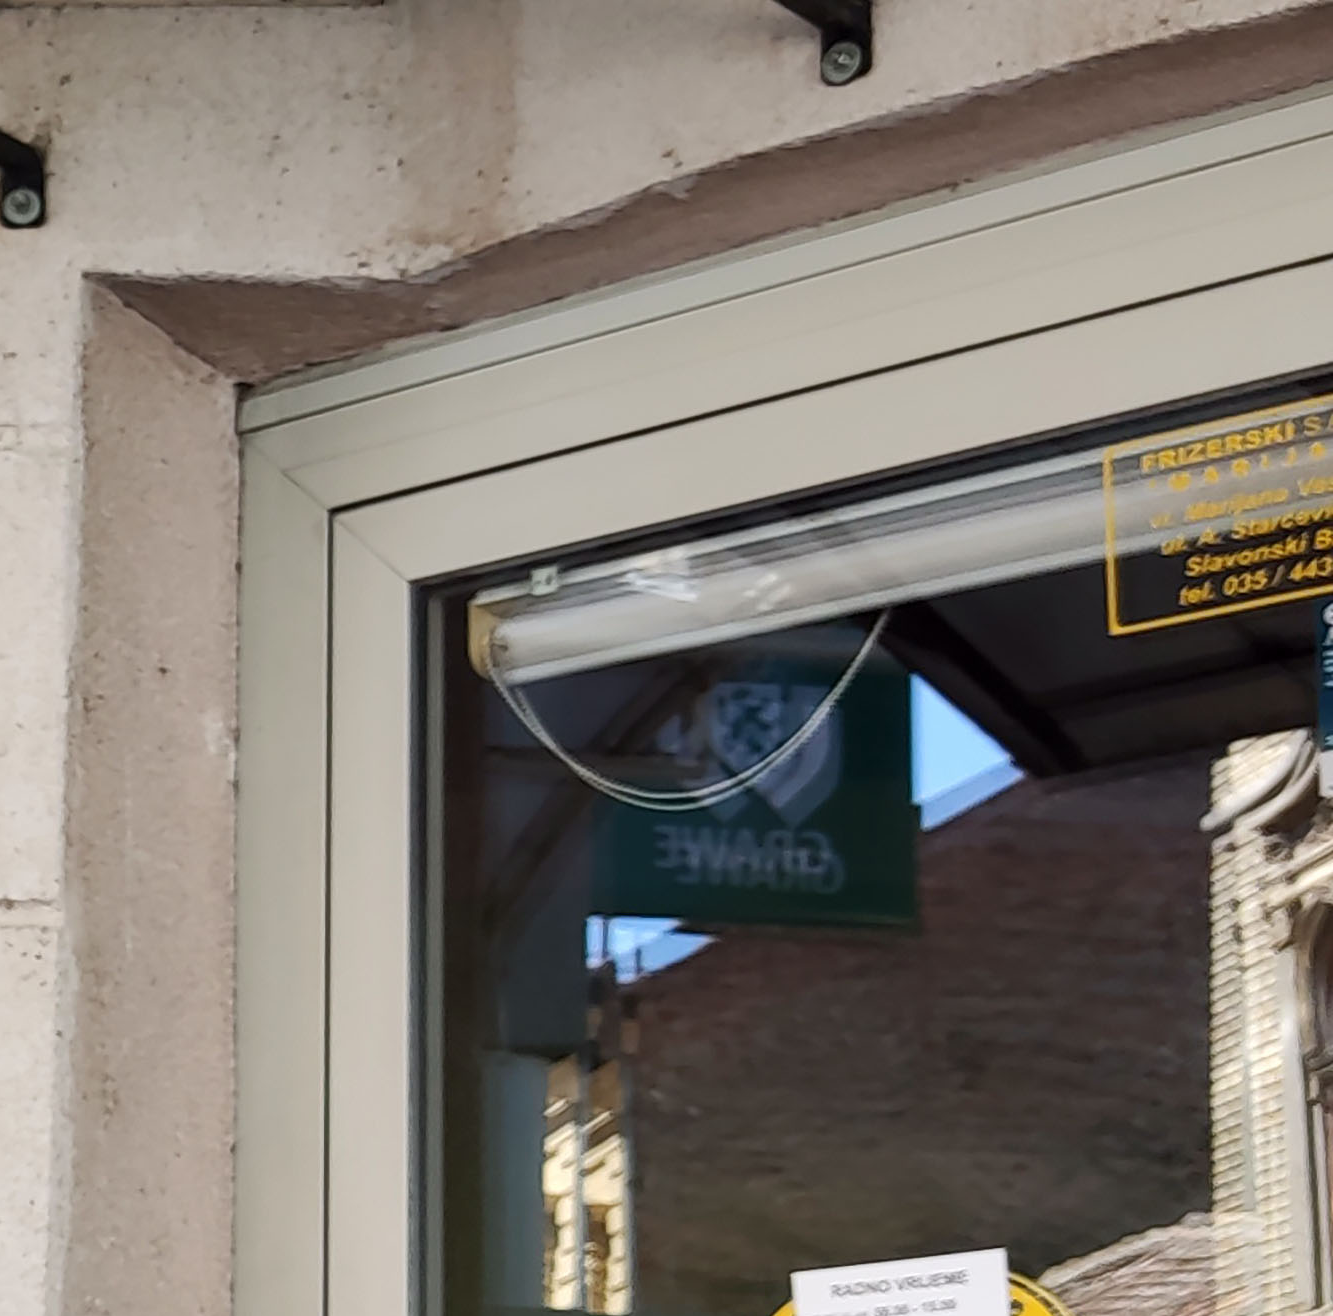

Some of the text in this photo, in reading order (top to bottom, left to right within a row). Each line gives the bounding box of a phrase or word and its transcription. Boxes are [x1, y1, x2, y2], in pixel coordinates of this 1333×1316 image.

[1141, 421, 1296, 474] FRIZERSKI
[1184, 532, 1309, 577] Slavonski
[1179, 580, 1215, 606] tel.
[1222, 567, 1269, 597] 035
